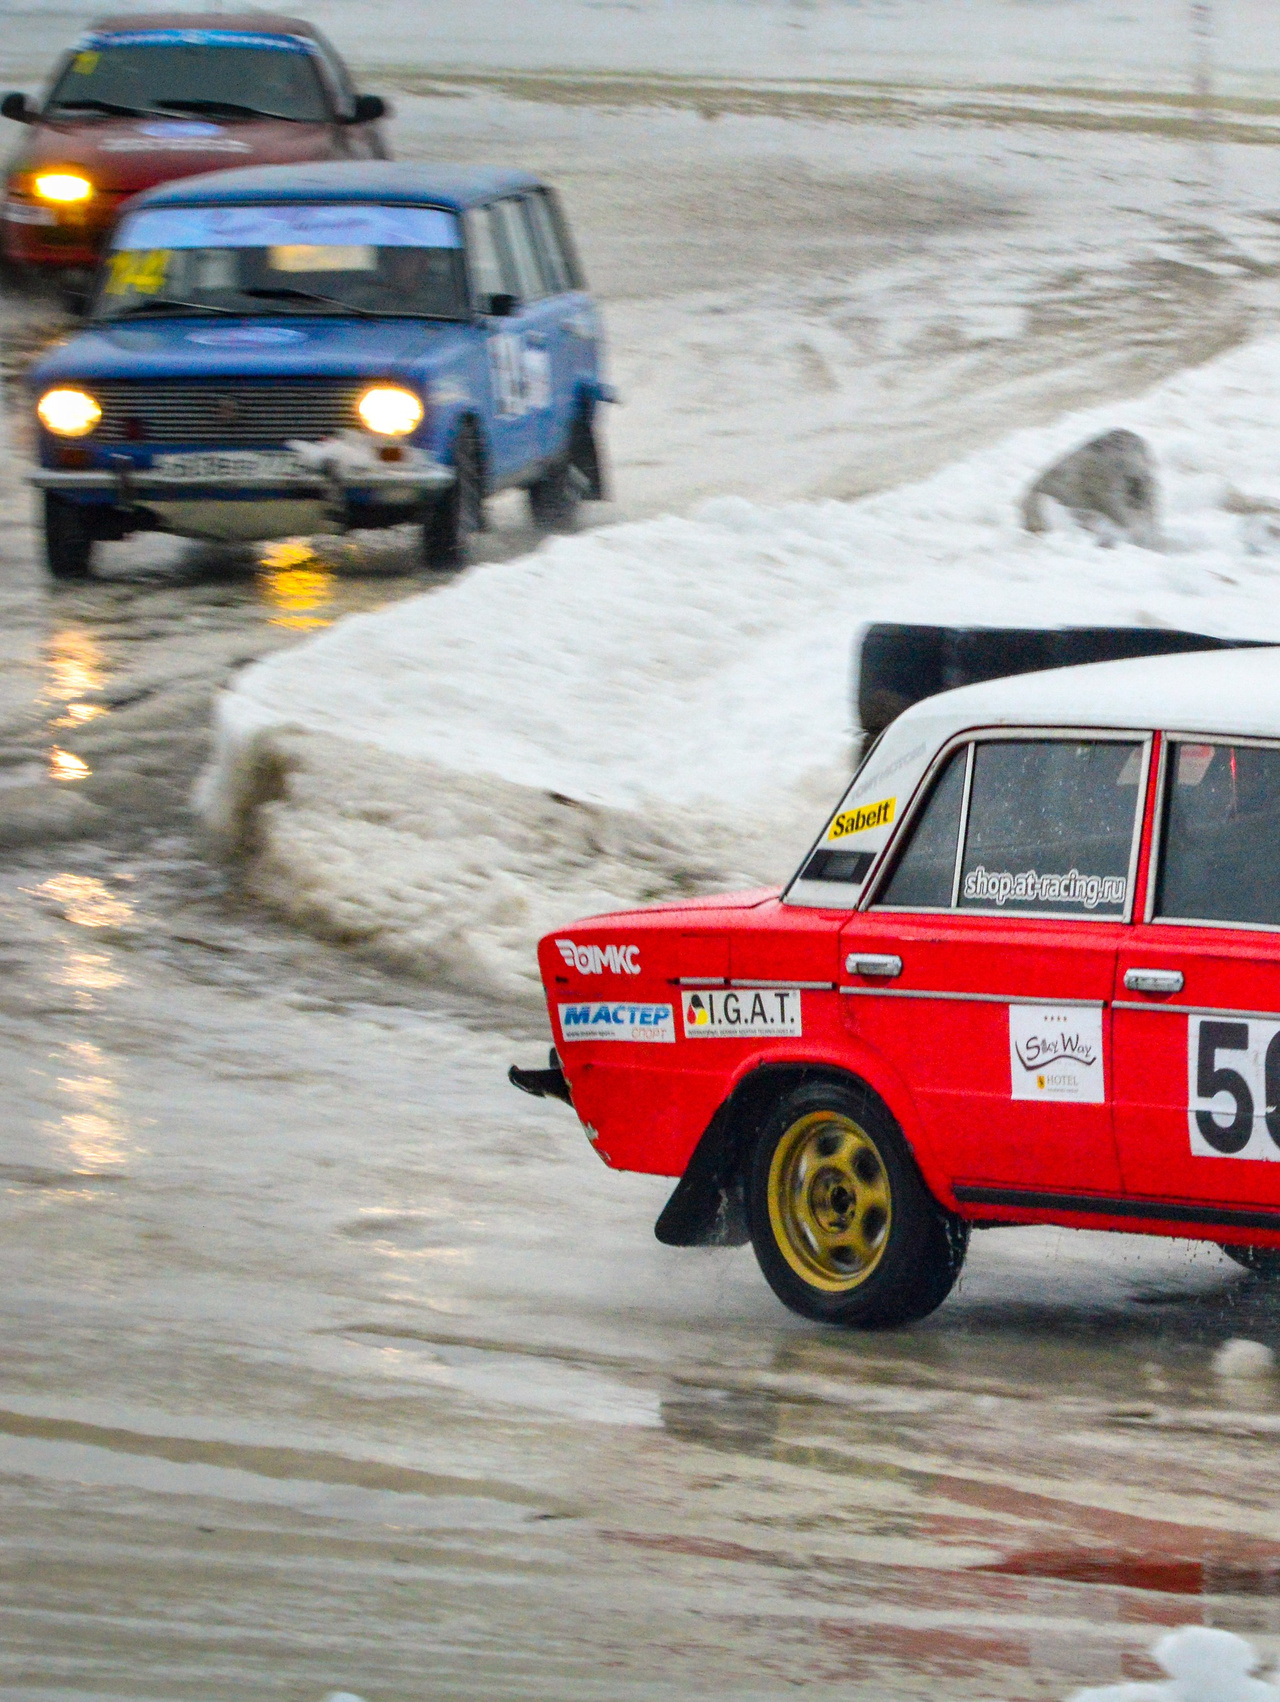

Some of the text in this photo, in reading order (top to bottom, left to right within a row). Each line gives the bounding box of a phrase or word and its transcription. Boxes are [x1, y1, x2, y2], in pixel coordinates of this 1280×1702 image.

[833, 801, 890, 837] Sabelt
[963, 866, 1127, 908] shop.at-racing.ru
[563, 1005, 671, 1026] МАСТЕР
[708, 992, 795, 1025] I.G.A.T.
[1060, 1032, 1092, 1058] Way
[1046, 1075, 1079, 1087] HOTEL
